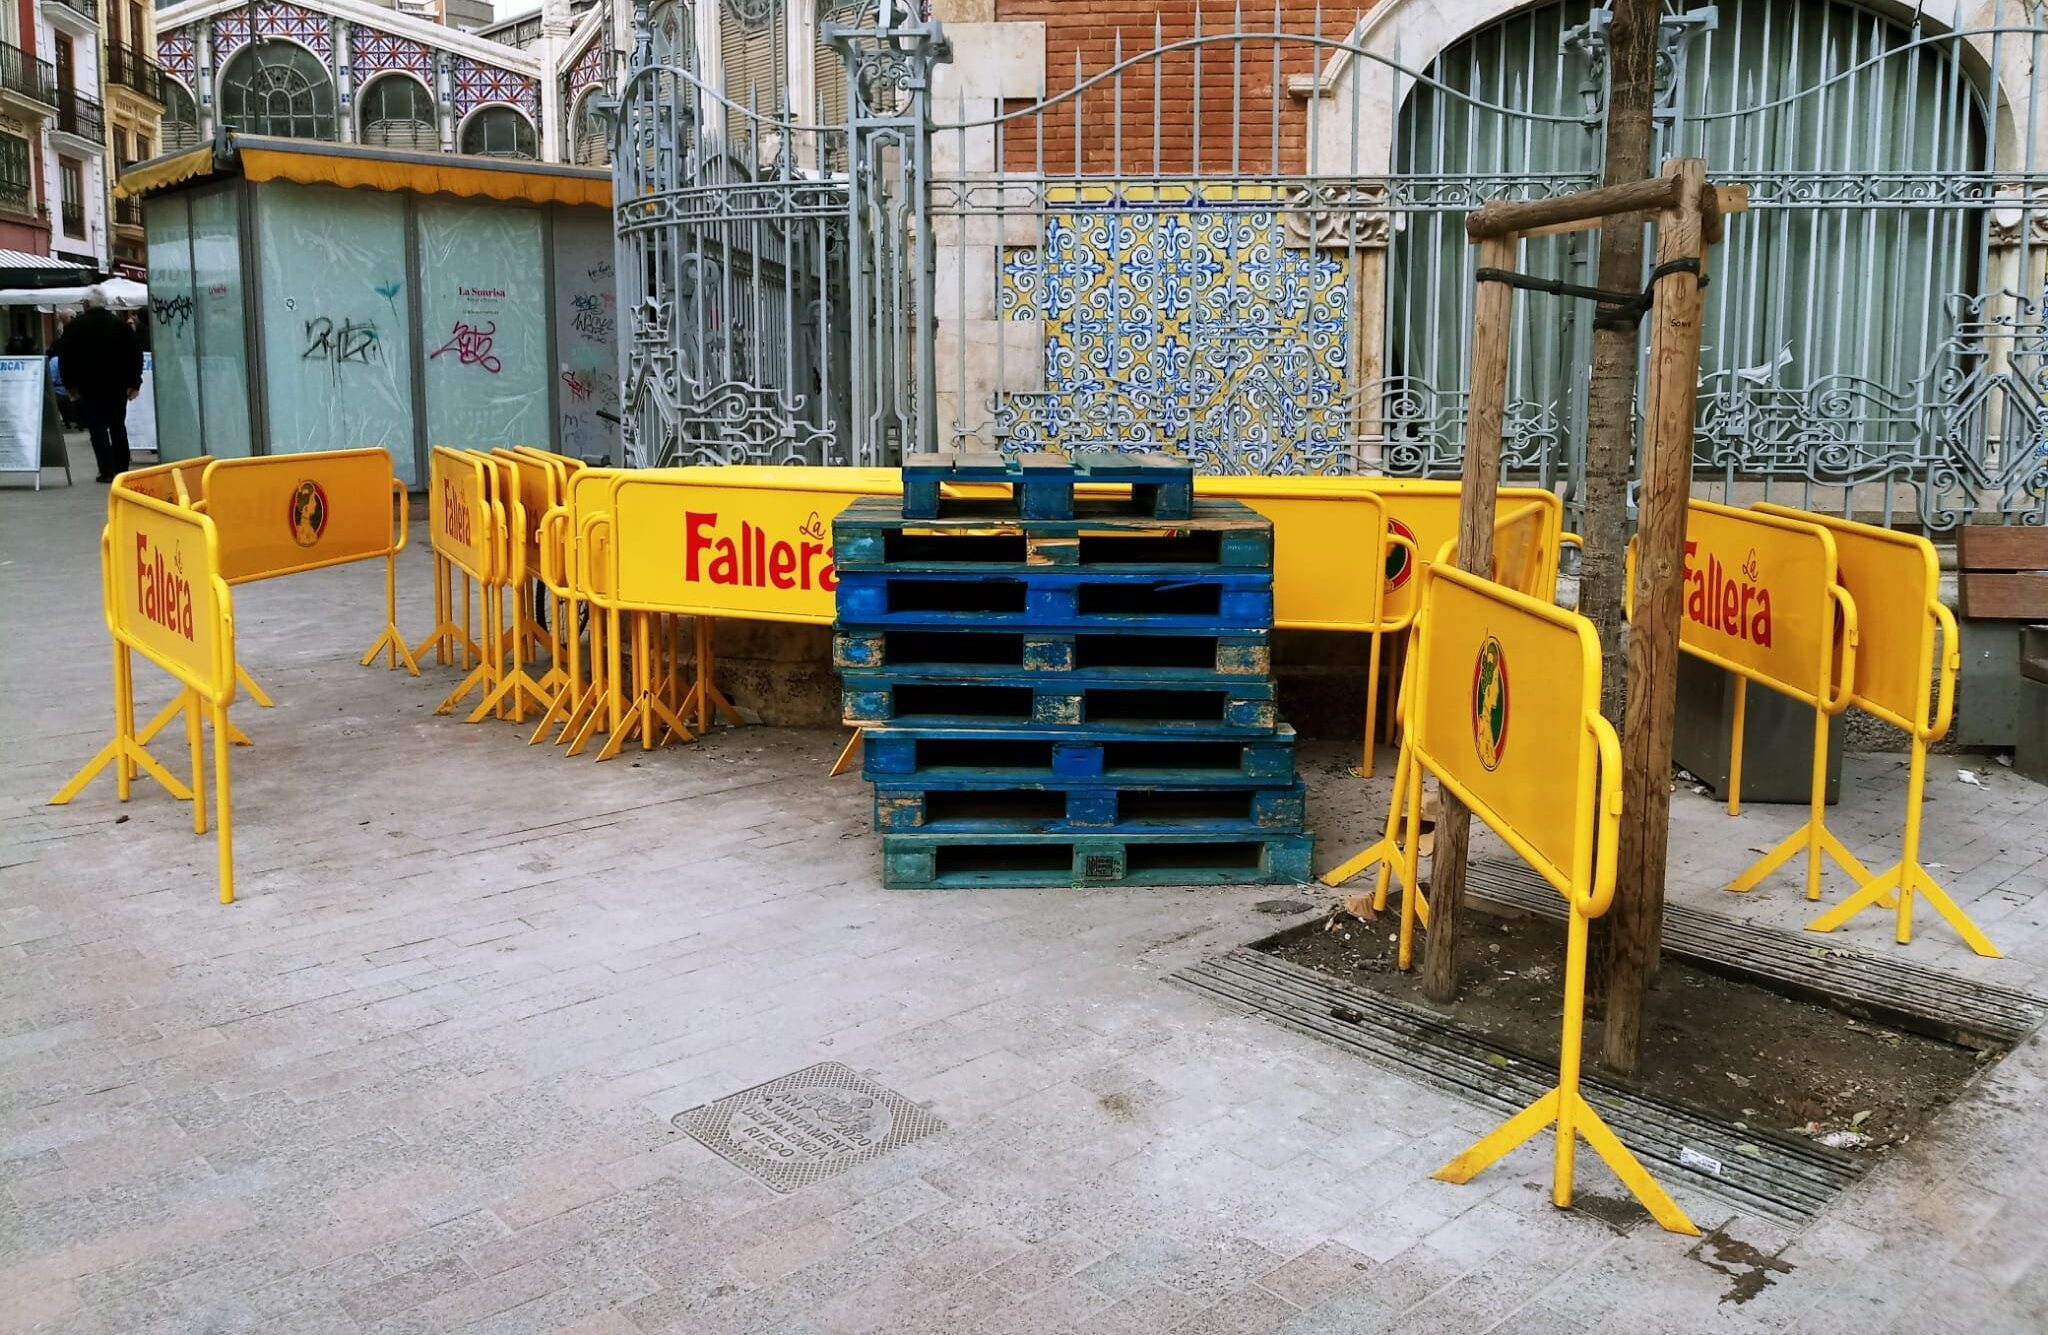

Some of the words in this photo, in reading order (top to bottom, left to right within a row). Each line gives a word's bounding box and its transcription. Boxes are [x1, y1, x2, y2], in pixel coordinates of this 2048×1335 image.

[459, 286, 470, 296] La
[471, 287, 506, 298] Sonrisa
[444, 478, 472, 549] Fallera
[799, 511, 826, 541] La
[136, 530, 194, 643] Fallera
[743, 1126, 795, 1158] RIEGO
[760, 1098, 855, 1154] AJUNTAMENT
[776, 1093, 812, 1111] ANY
[833, 1124, 872, 1147] 2020
